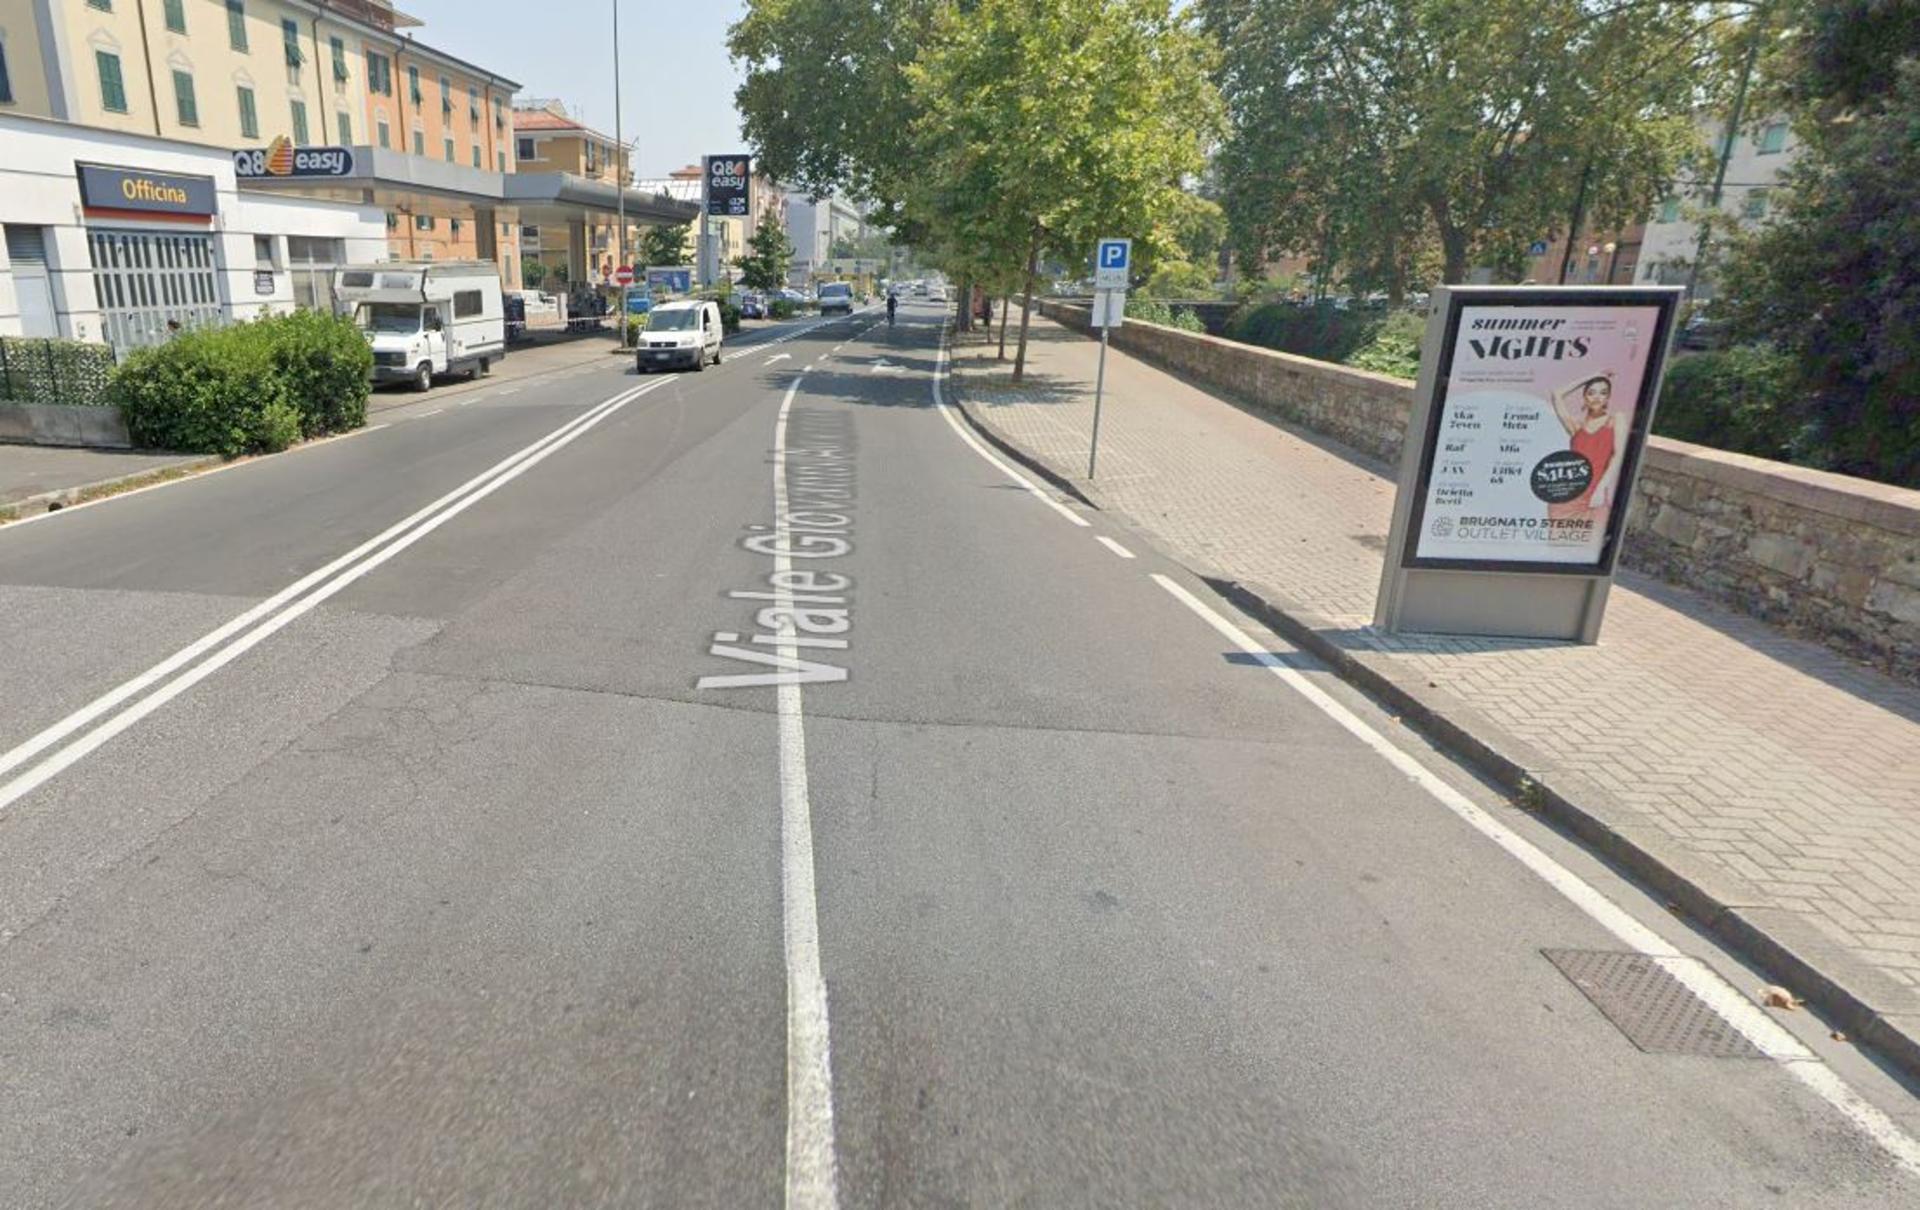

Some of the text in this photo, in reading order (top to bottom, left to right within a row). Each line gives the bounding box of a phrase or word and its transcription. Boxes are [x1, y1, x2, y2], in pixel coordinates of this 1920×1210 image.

[235, 150, 345, 175] Q8 easy
[711, 160, 734, 176] Q8
[711, 176, 746, 190] easy
[121, 179, 188, 205] Officina
[1106, 246, 1123, 266] P
[1470, 315, 1568, 332] summer
[1468, 335, 1592, 361] NIGHTS
[1458, 516, 1538, 528] BRUGNATO
[1457, 527, 1593, 543] OUTLET VILLAGE
